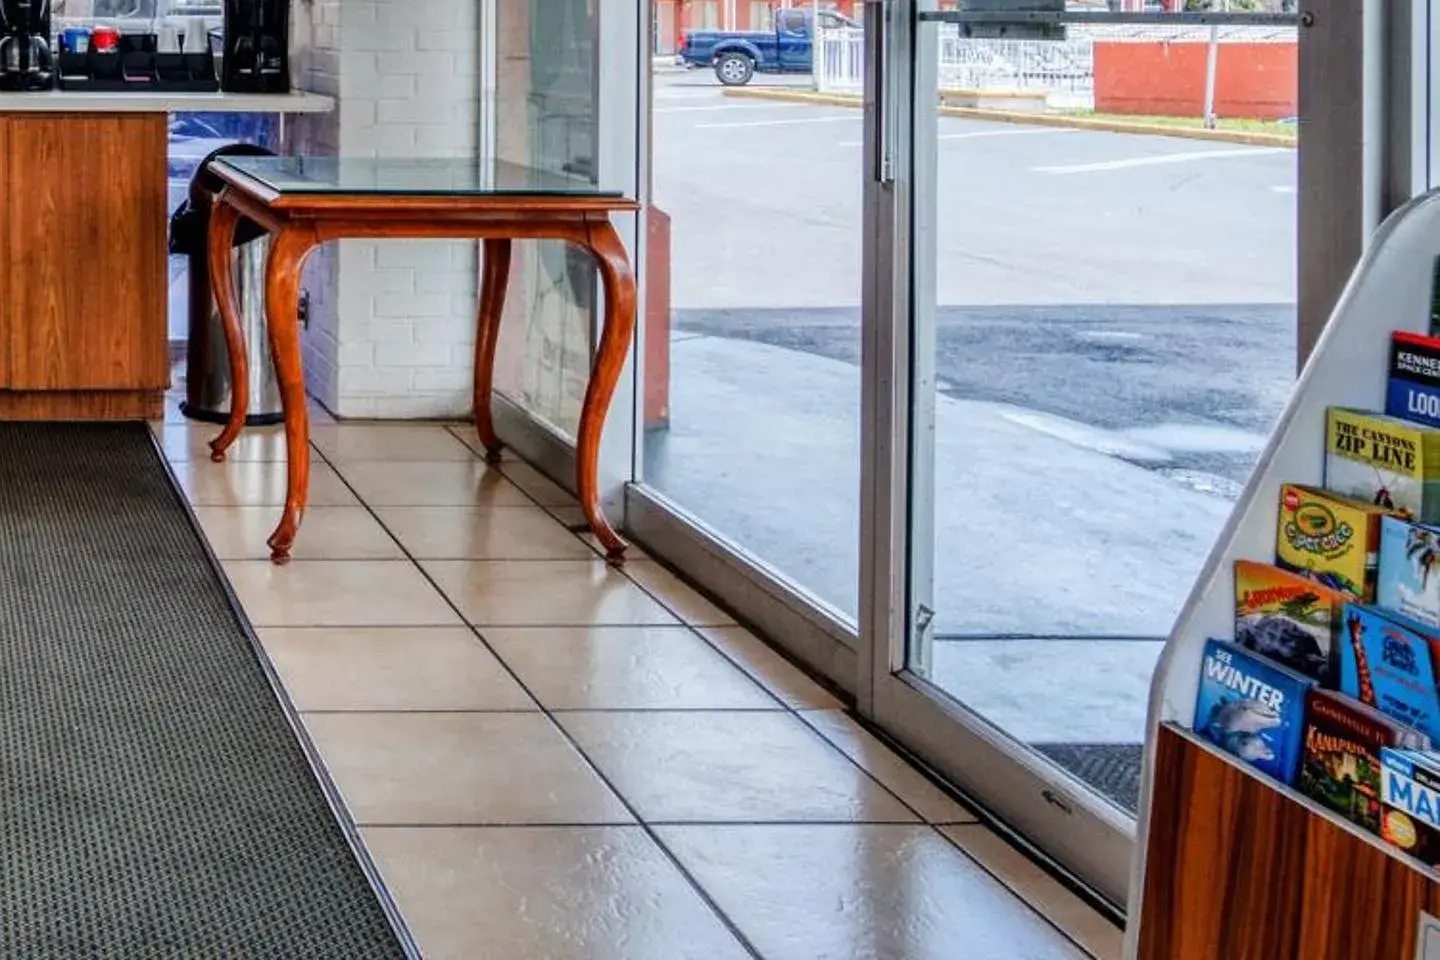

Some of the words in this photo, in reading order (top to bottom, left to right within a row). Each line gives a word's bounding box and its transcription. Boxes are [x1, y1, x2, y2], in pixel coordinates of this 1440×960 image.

[1397, 351, 1440, 372] KENNE
[1408, 389, 1440, 418] LOO
[1335, 421, 1359, 436] THE
[1335, 433, 1366, 455] ZIP
[1371, 442, 1417, 471] LINE
[1216, 649, 1233, 664] SEE
[1206, 655, 1284, 713] WINTER
[1389, 772, 1440, 825] MA
